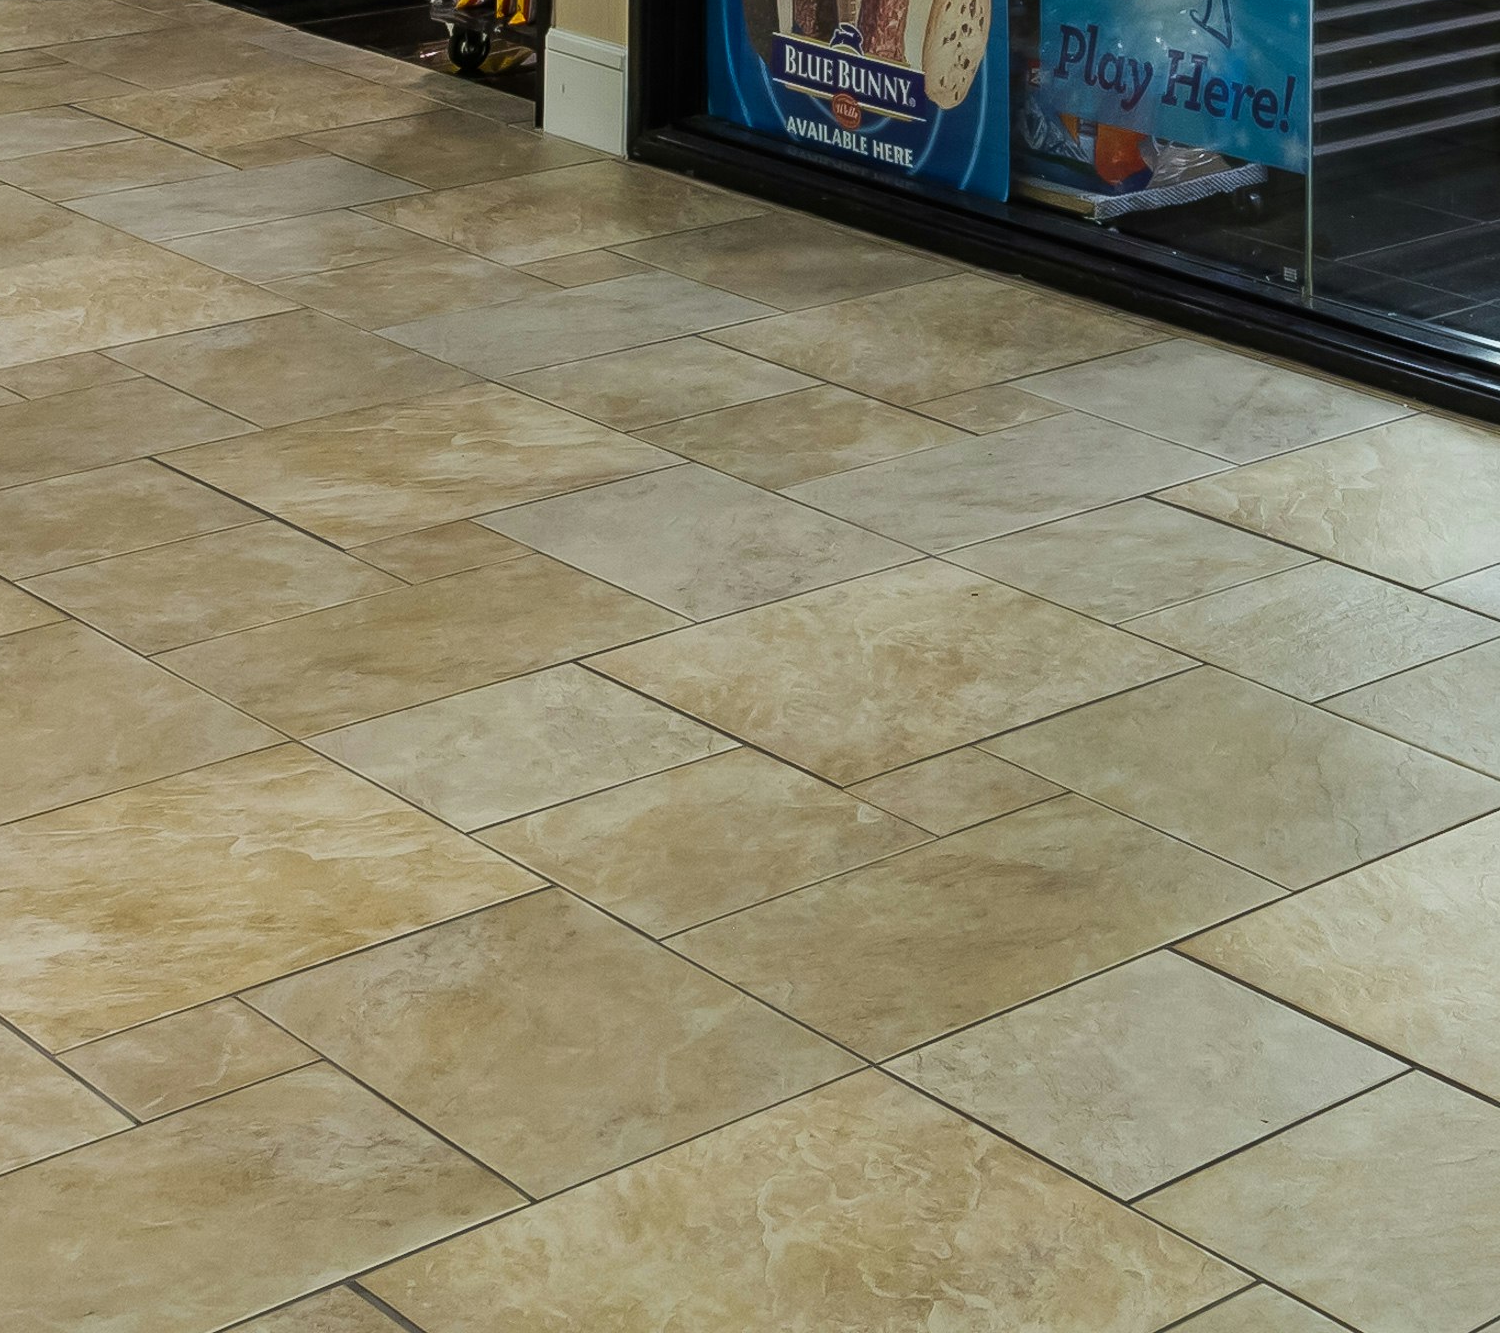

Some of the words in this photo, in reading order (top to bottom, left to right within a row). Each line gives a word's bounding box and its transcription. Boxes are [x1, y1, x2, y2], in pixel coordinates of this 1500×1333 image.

[785, 44, 833, 85] BLUE
[838, 59, 912, 106] BUNNY
[1053, 25, 1153, 112] Play
[1161, 49, 1298, 133] Here!
[787, 116, 868, 155] AVAILABLE
[873, 139, 913, 168] HERE
